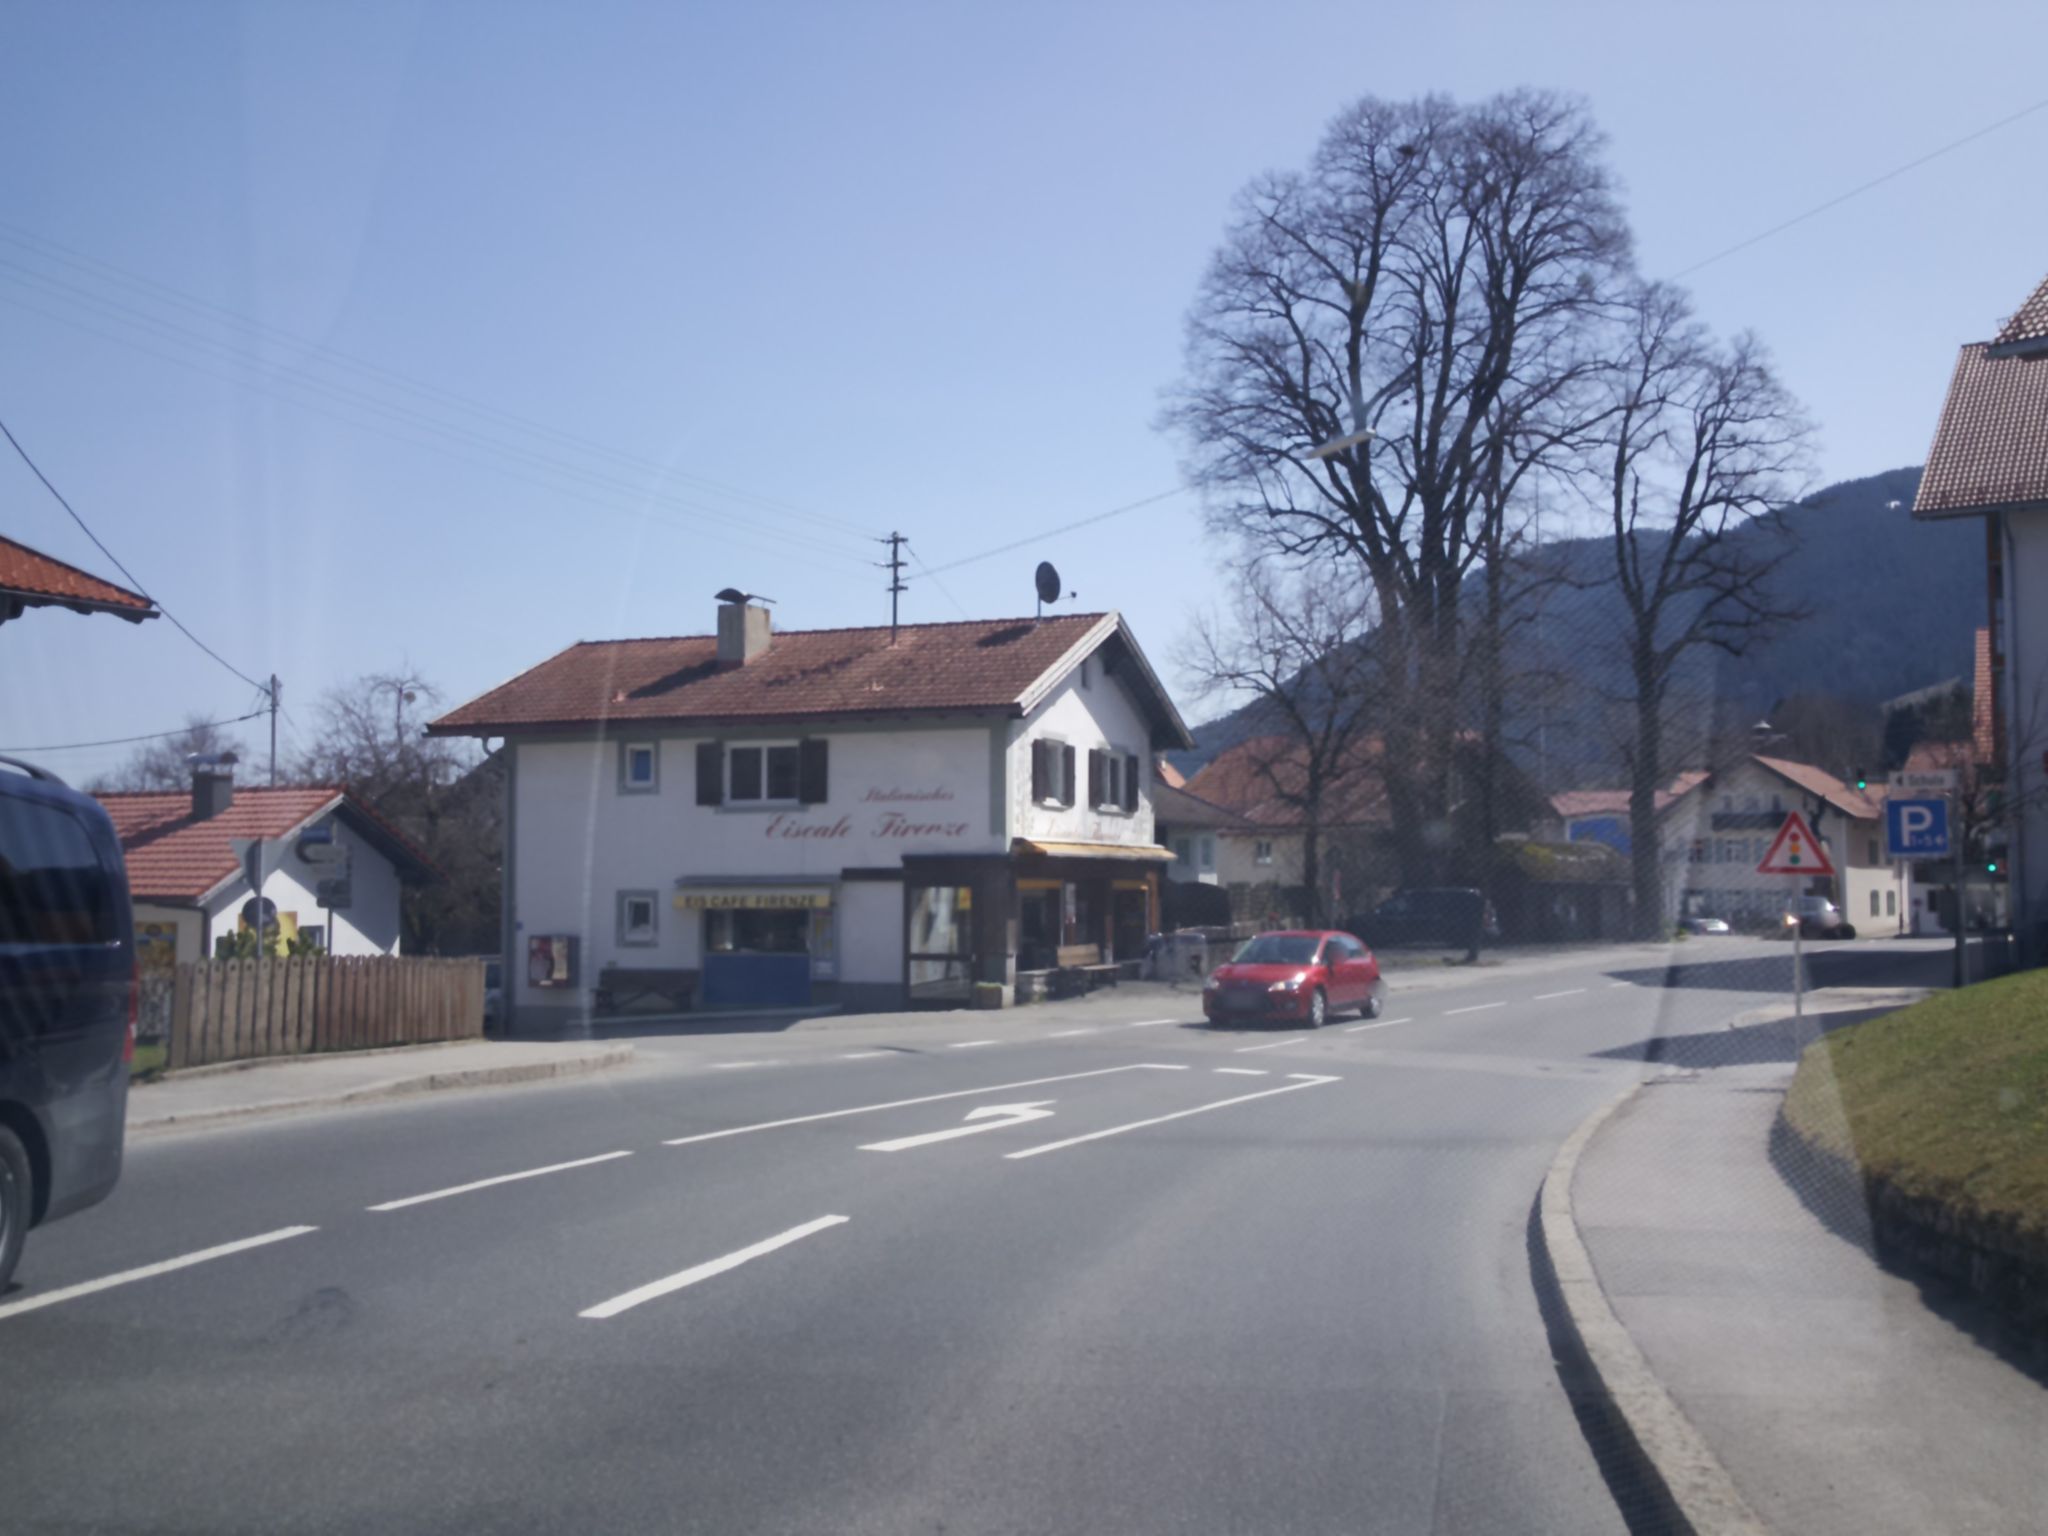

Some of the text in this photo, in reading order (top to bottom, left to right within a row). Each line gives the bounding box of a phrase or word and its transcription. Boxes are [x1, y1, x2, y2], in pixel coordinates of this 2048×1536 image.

[871, 811, 970, 838] Firenze
[1900, 806, 1933, 847] P
[755, 894, 814, 908] FIRENZE
